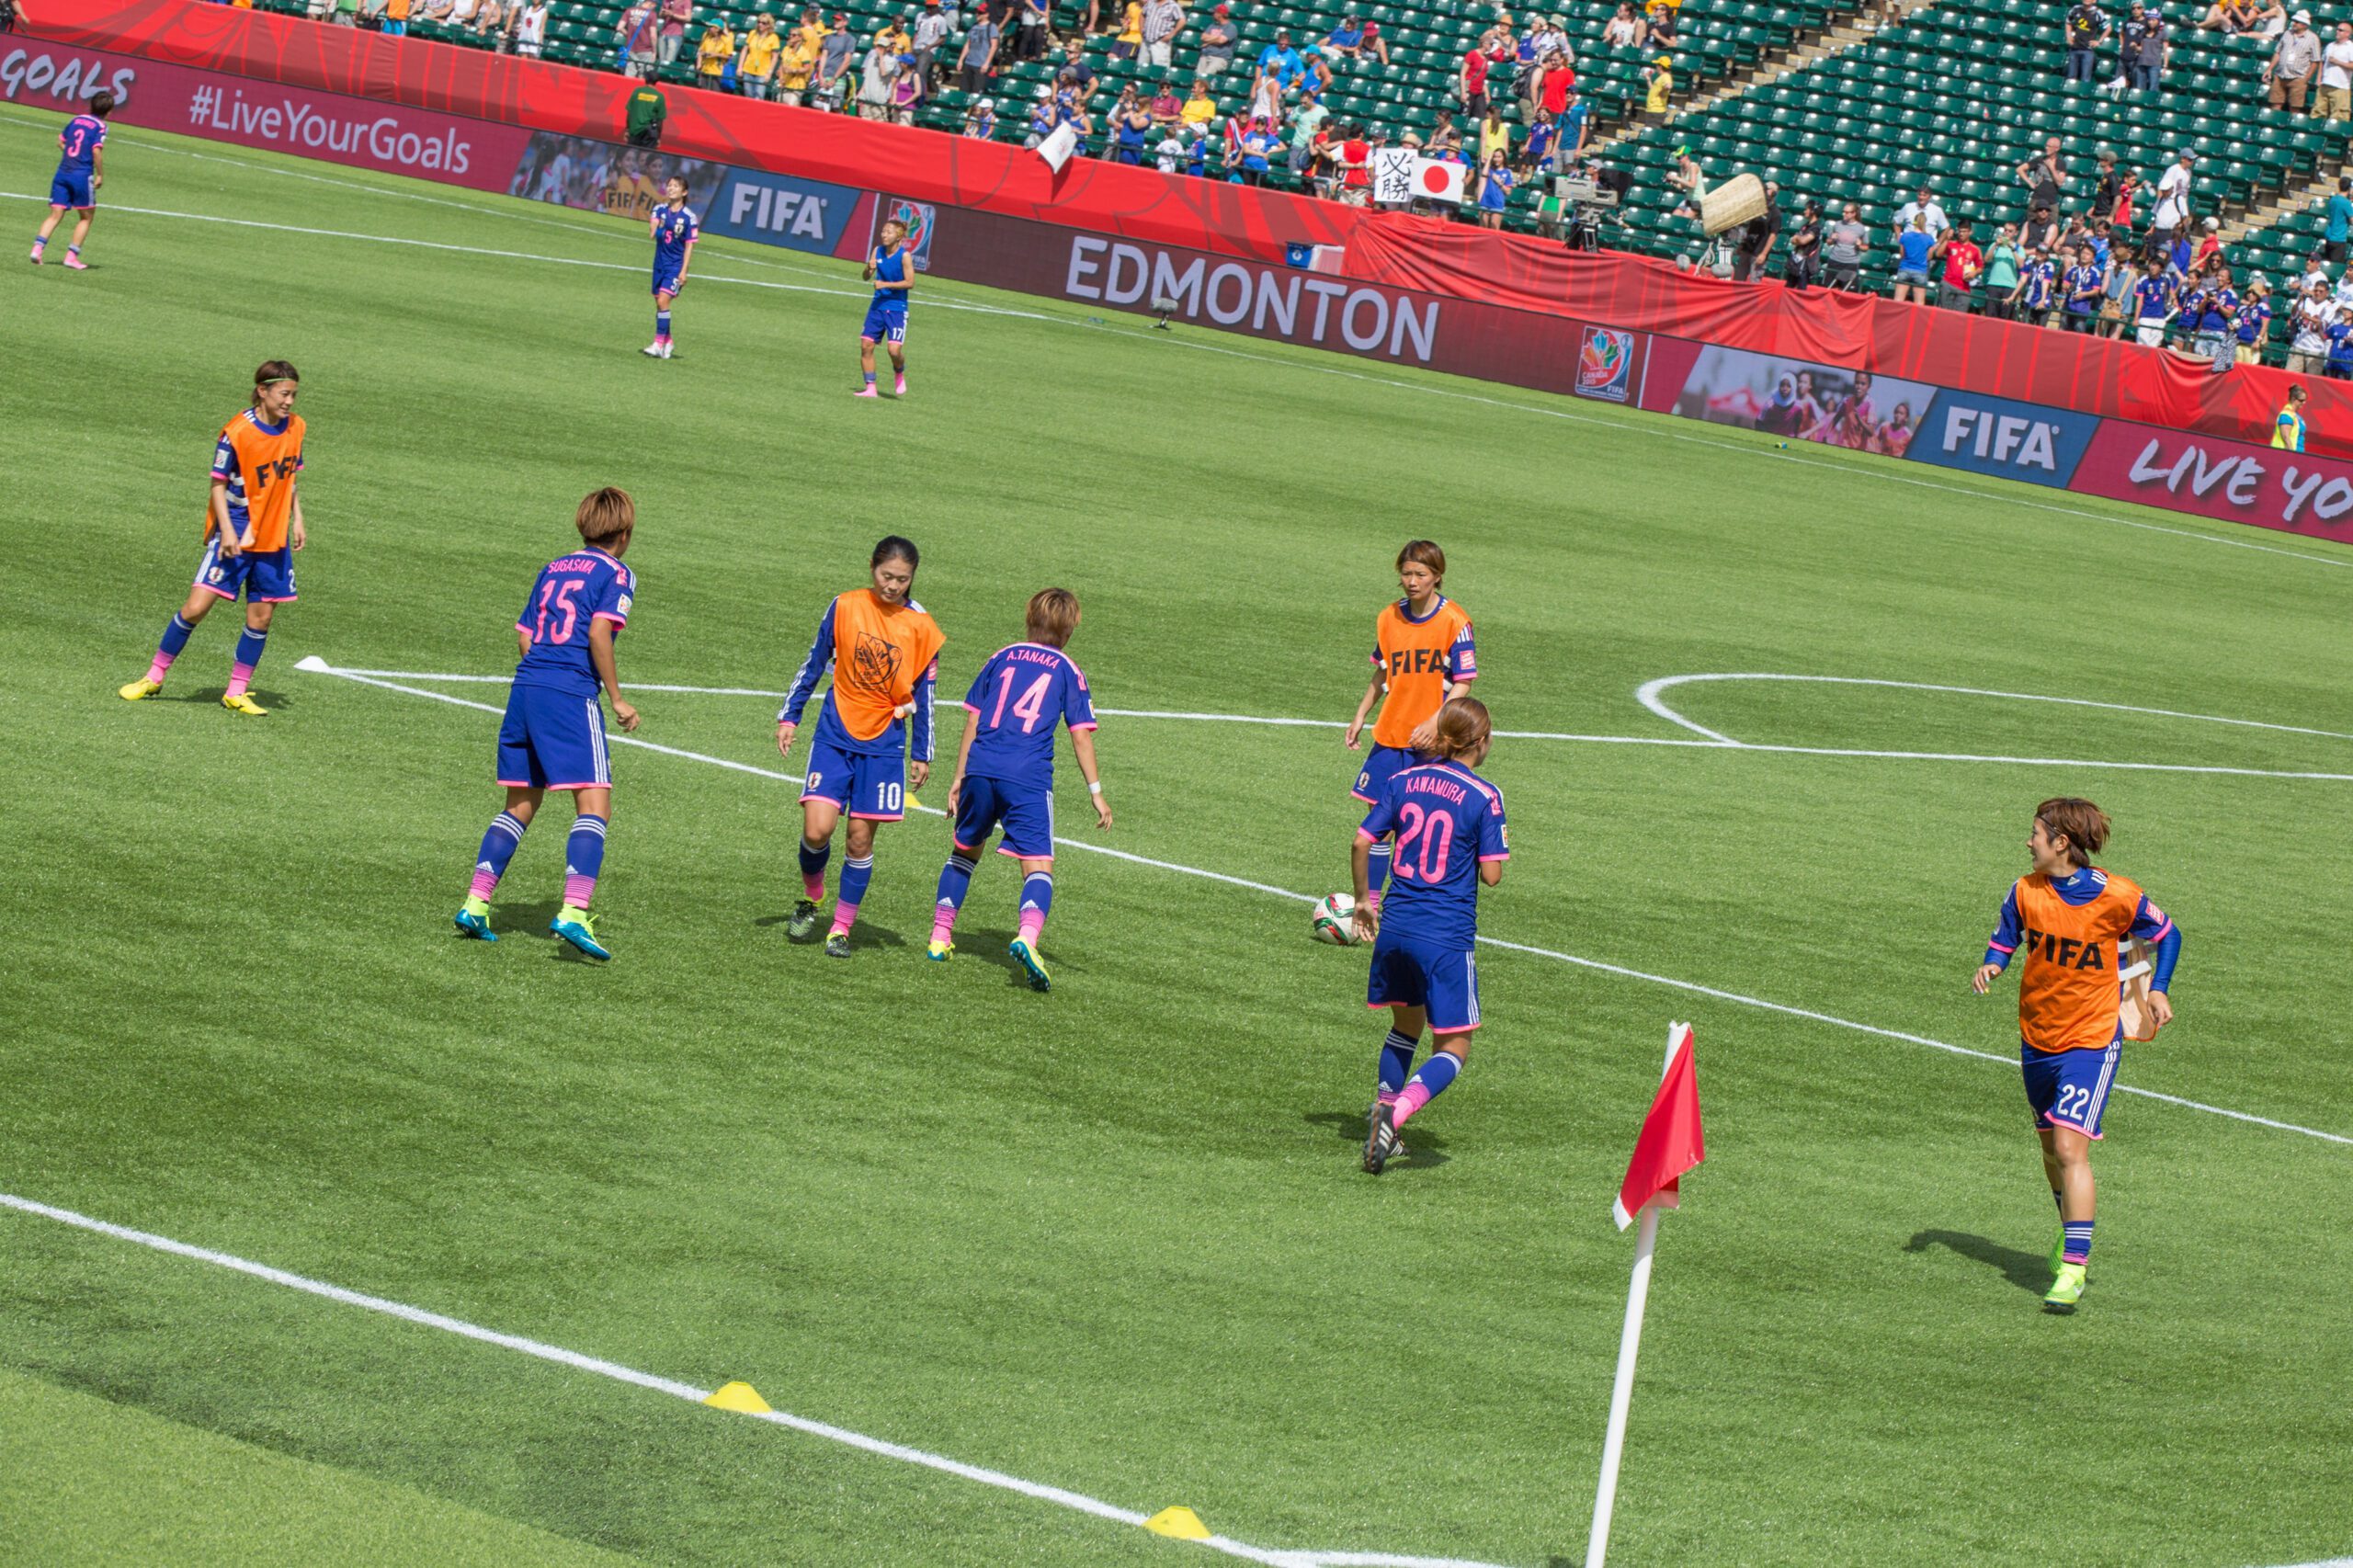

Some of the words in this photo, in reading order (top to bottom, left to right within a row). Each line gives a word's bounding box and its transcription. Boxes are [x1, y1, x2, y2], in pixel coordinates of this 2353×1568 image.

[1, 49, 135, 105] GOALS
[67, 129, 85, 157] 3
[189, 85, 471, 174] #LiveYourGoals
[1381, 152, 1415, 200] 必勝
[730, 182, 825, 240] FIFA
[1065, 235, 1440, 361] EDMONTON
[892, 327, 903, 340] 17
[1942, 405, 2057, 471] FIFA
[2129, 438, 2267, 505] LIVE
[534, 579, 585, 644] 15
[1006, 650, 1060, 669] A.TANAKA
[1391, 649, 1445, 676] FIFA
[990, 666, 1052, 733] 14
[877, 781, 902, 811] 10
[1406, 776, 1467, 806] KAWAMURA
[1392, 802, 1454, 884] 20
[2027, 928, 2104, 971] FIFA
[2057, 1084, 2090, 1121] 22
